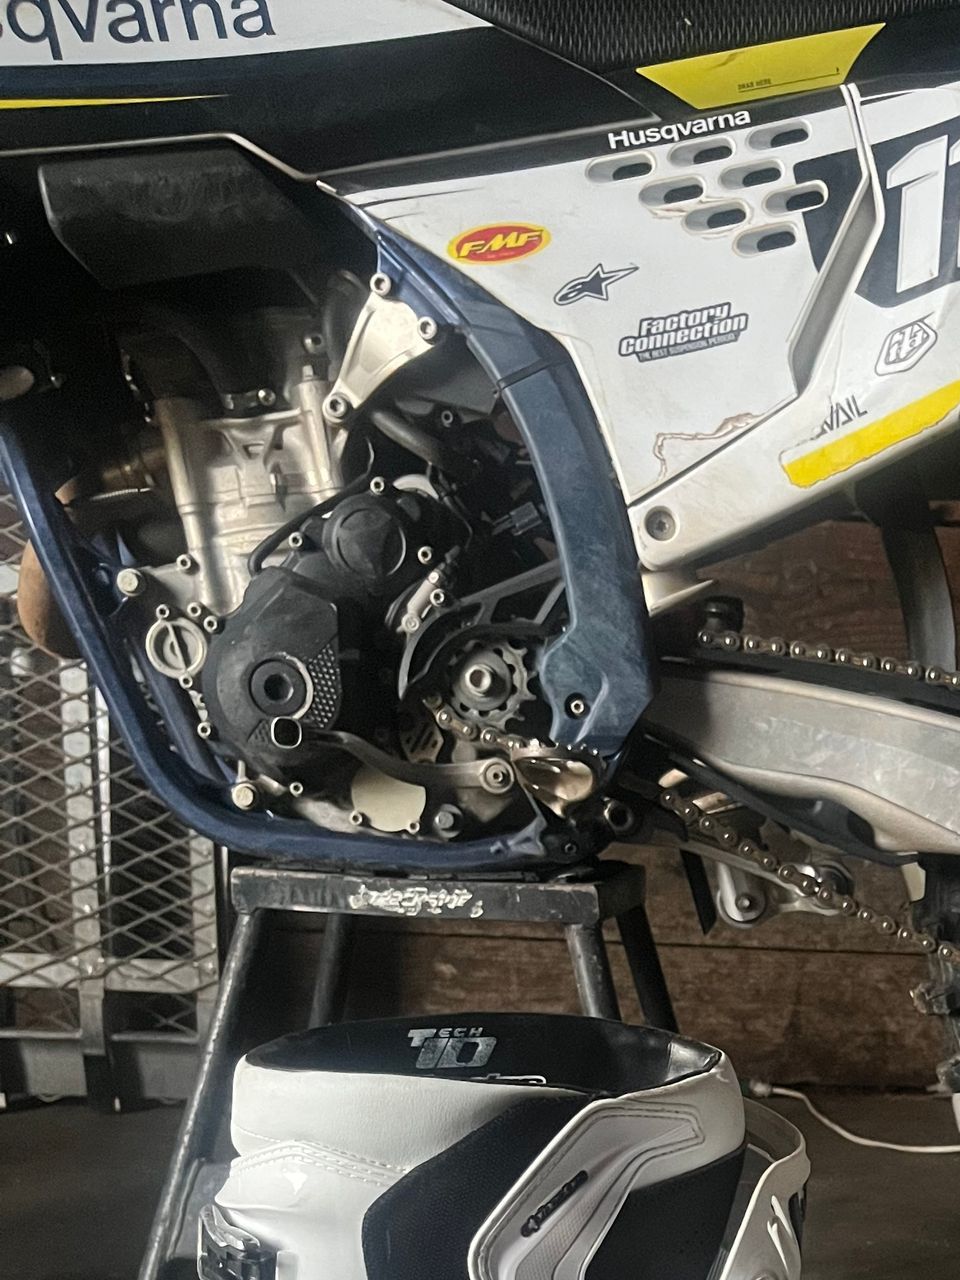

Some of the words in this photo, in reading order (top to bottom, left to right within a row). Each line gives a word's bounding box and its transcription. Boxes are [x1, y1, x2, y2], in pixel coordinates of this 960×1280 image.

[0, 0, 277, 61] qvarna
[608, 110, 751, 149] Husqvarna
[458, 229, 544, 258] FMF
[619, 314, 748, 355] Connection
[640, 303, 731, 337] Factory
[407, 1027, 484, 1048] TECH
[415, 1036, 497, 1069] 10
